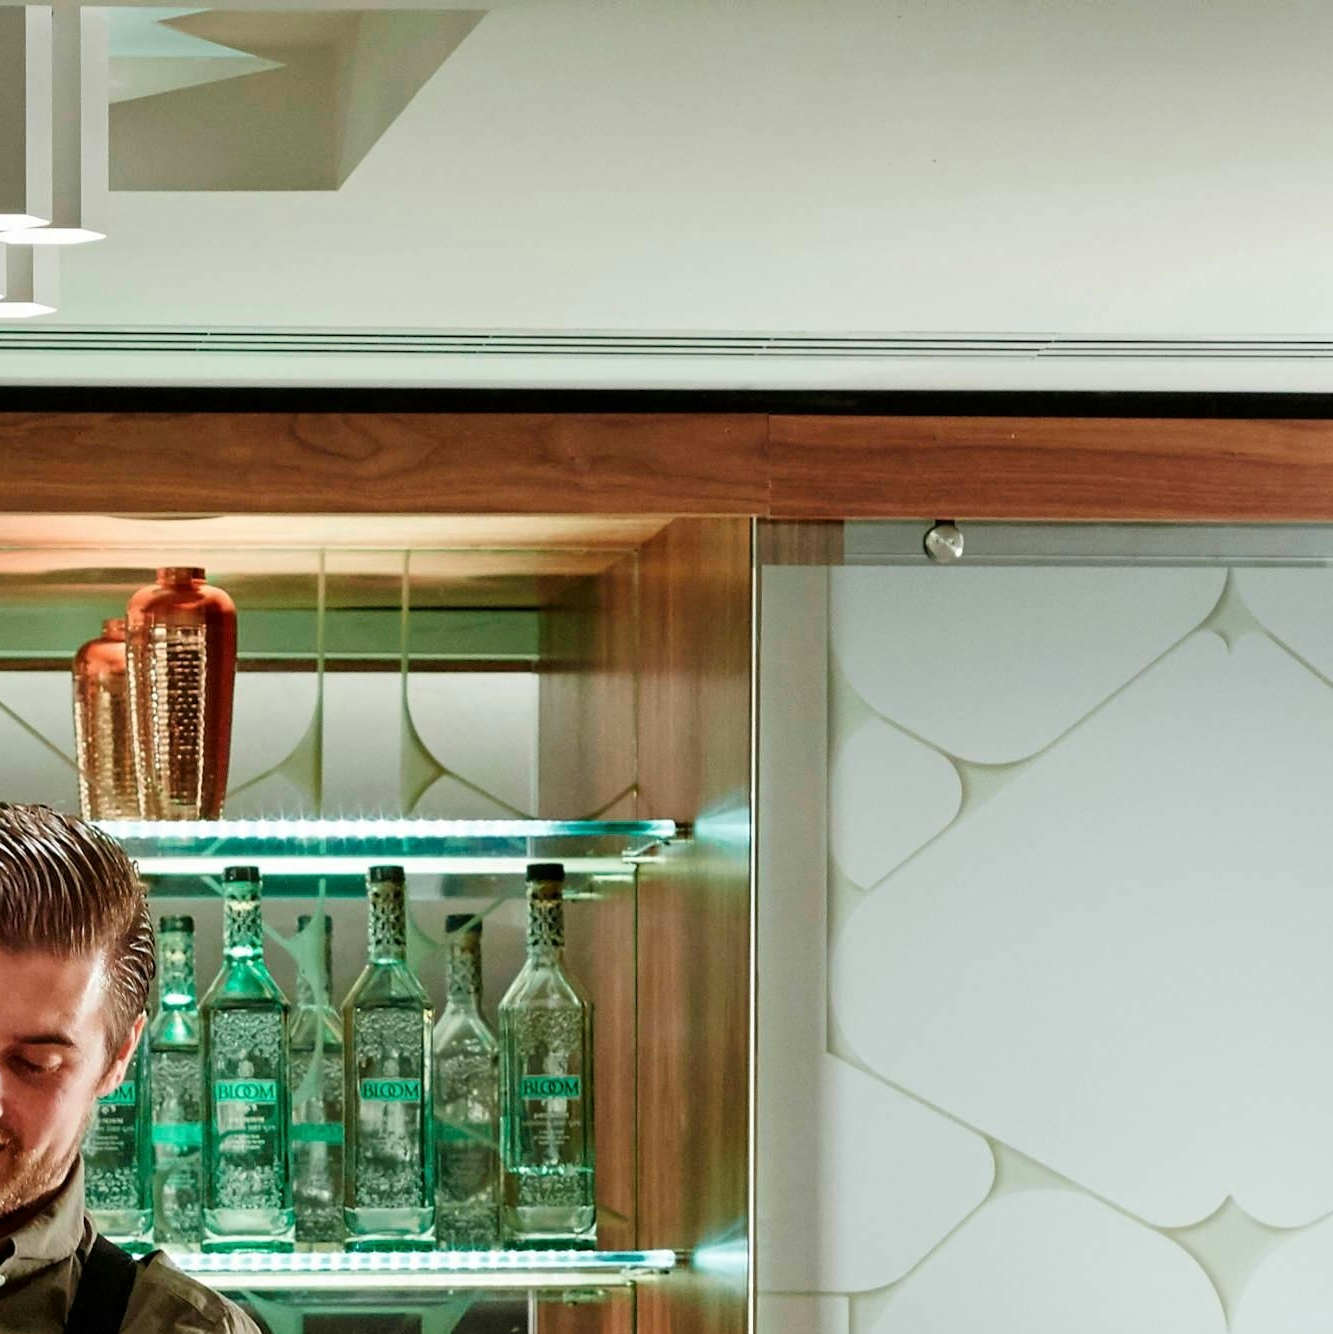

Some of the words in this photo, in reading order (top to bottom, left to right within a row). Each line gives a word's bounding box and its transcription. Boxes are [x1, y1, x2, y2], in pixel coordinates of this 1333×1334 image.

[217, 1084, 275, 1099] BLOOM
[362, 1082, 420, 1098] BLOOM
[522, 1080, 580, 1096] BLOOM
